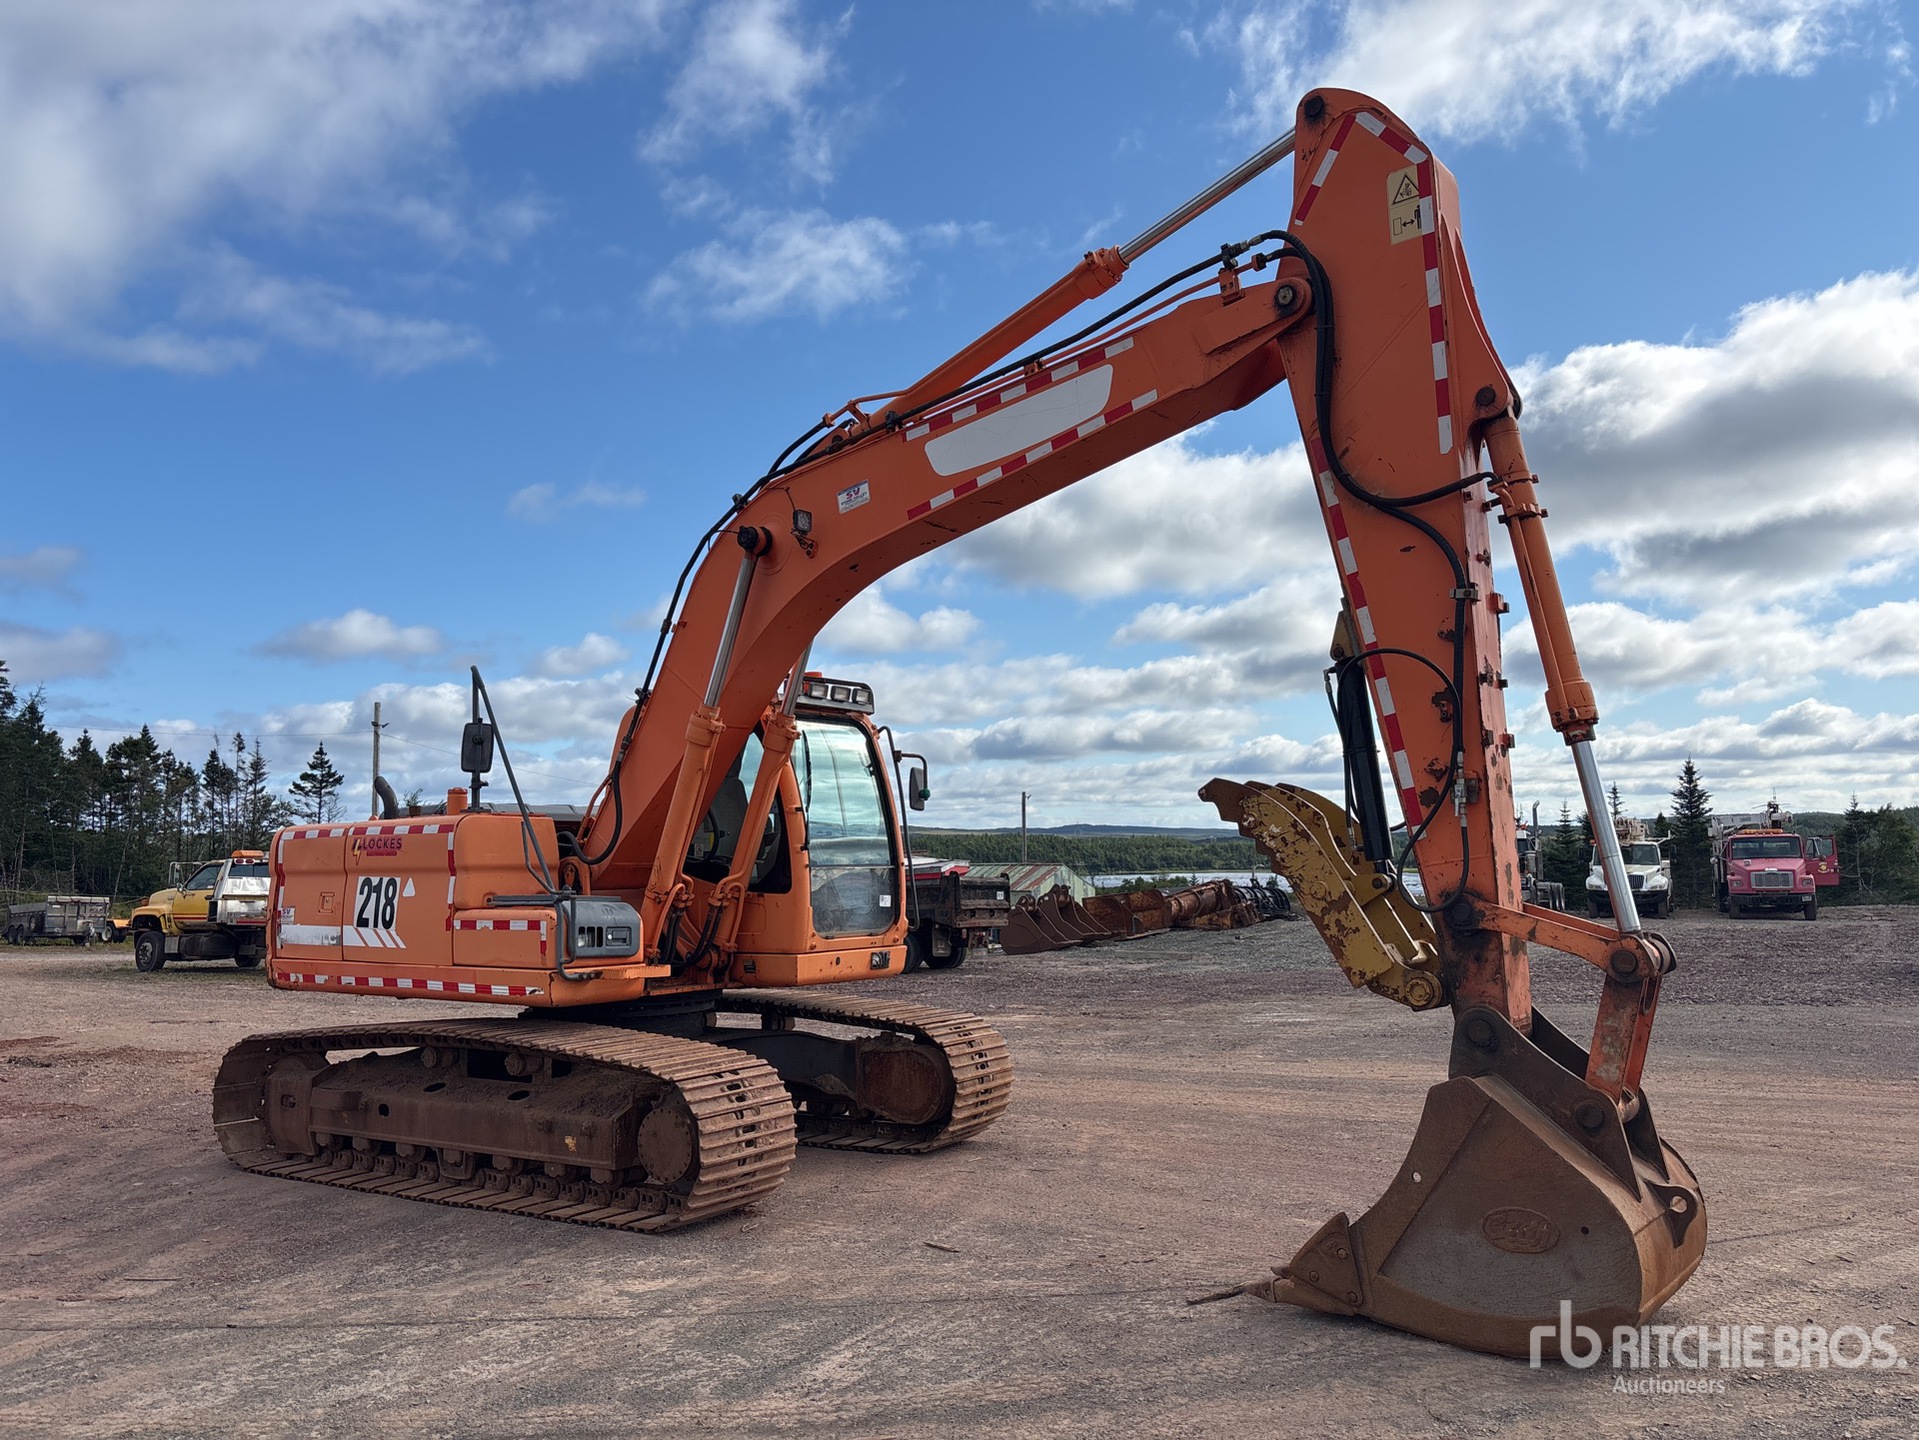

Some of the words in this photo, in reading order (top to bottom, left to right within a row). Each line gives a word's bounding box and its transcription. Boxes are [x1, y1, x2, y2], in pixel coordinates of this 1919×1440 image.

[846, 487, 860, 500] SV
[363, 838, 402, 850] LOCKES
[356, 877, 398, 930] 218
